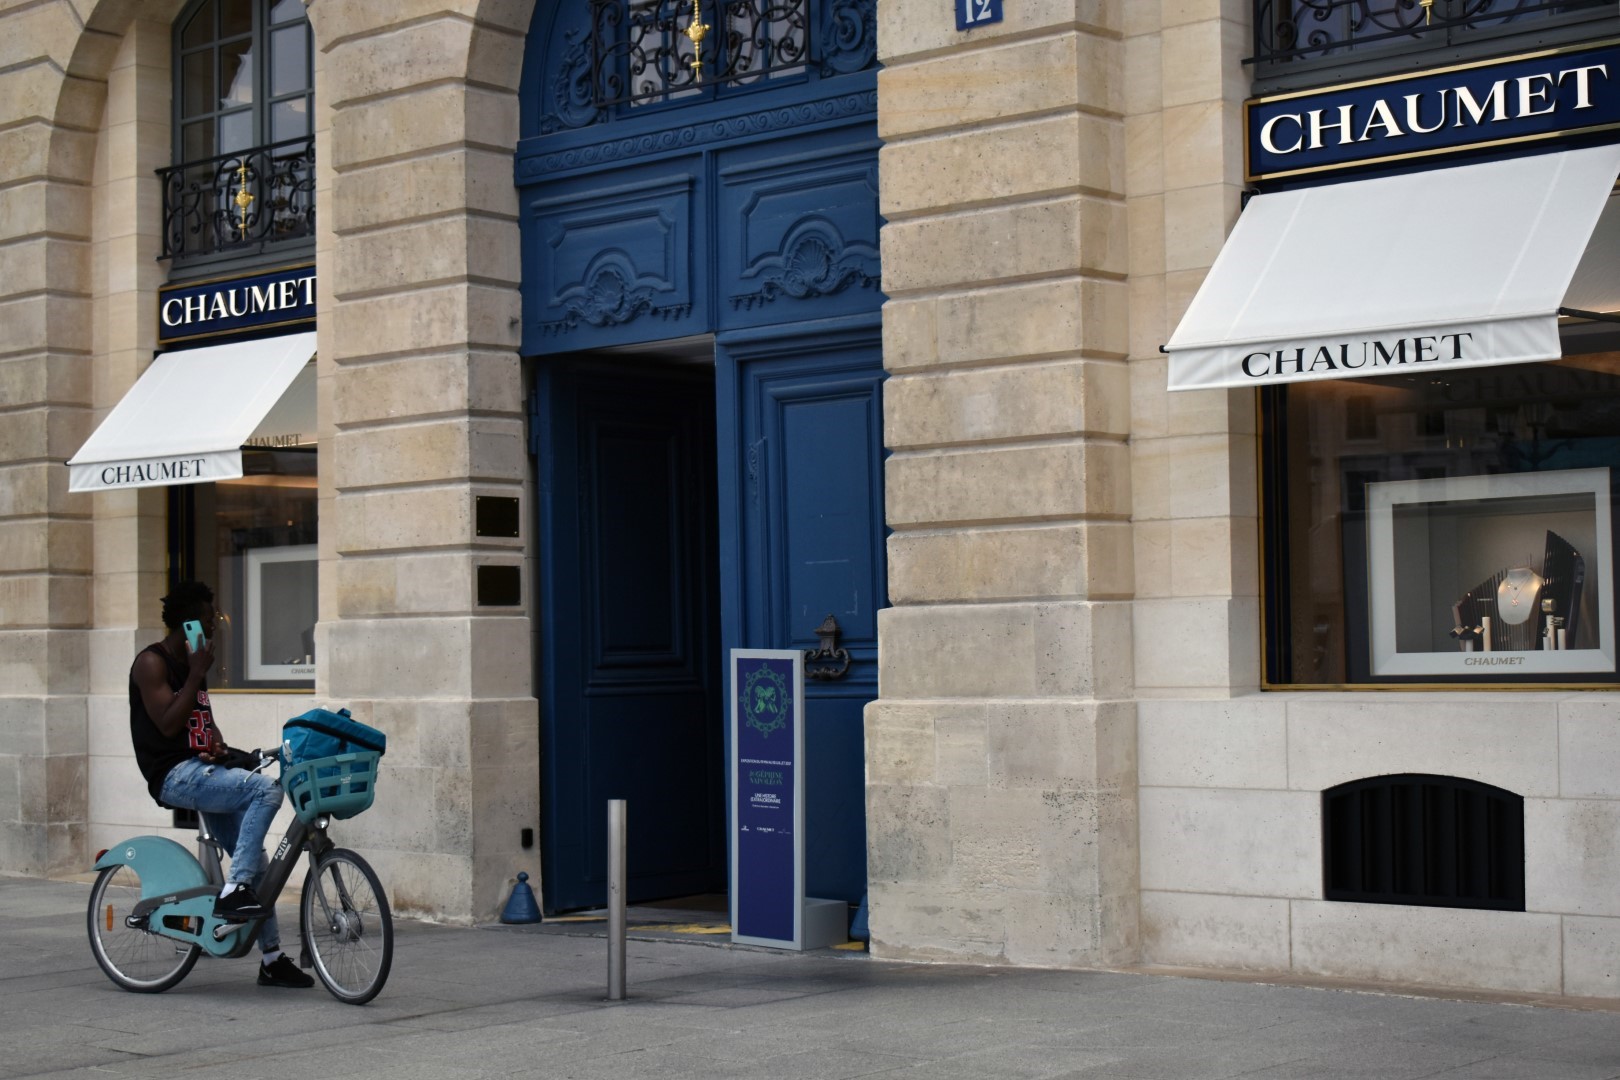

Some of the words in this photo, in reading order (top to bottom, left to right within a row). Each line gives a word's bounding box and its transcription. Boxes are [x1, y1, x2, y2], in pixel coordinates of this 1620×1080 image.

[965, 0, 992, 23] 12
[1260, 64, 1608, 154] CHAUMET
[162, 275, 317, 327] CHAUMET
[1241, 332, 1473, 378] CHAUMET
[246, 433, 302, 447] HAUMET
[101, 458, 206, 485] CHAUMET
[1464, 656, 1526, 666] CHAUMET
